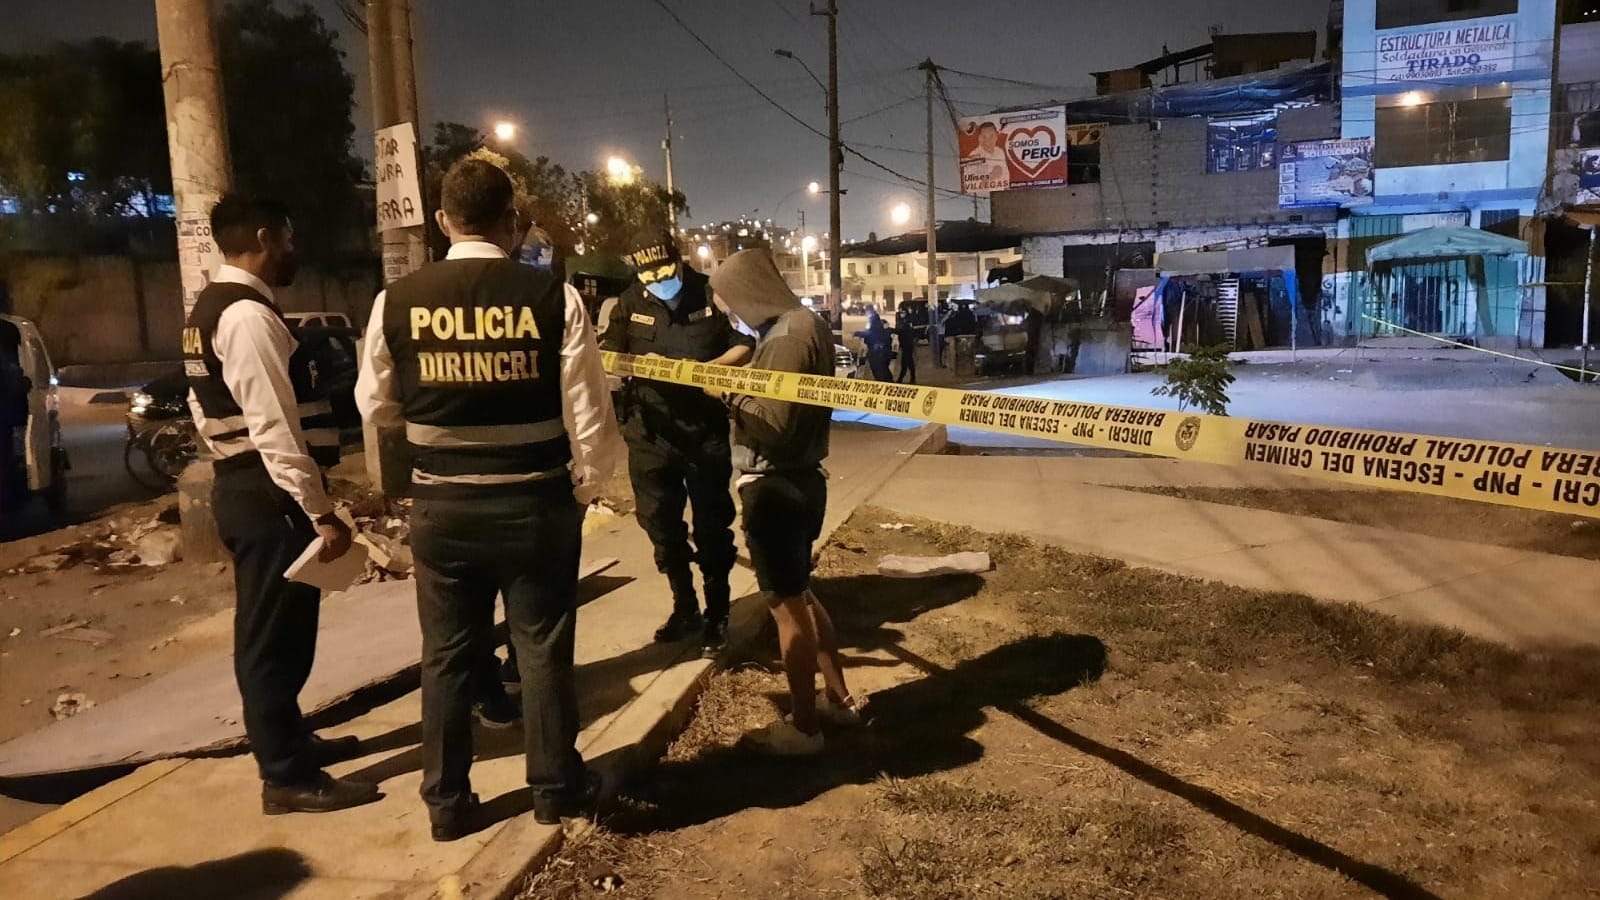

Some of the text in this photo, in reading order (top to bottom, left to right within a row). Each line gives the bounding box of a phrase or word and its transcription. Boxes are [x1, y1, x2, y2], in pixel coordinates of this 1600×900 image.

[1380, 24, 1511, 52] ESTRUCTURA METALICA
[1381, 49, 1447, 63] Soldadura
[1449, 48, 1461, 56] en
[1406, 53, 1481, 72] TIRADO
[376, 137, 399, 157] TAR
[1008, 138, 1040, 149] SOMOS
[1021, 145, 1061, 161] PERU
[964, 173, 989, 182] Ulises
[964, 179, 1009, 191] VILLEGAS
[418, 350, 540, 382] DIRINCRI
[796, 388, 818, 401] CRIMEN
[798, 376, 919, 399] BARRERA POLICIAL PROHIBIDO PASAR
[821, 391, 832, 402] DEL
[833, 393, 857, 406] ESCENA
[864, 396, 877, 409] PNP
[884, 398, 911, 414] DIRCRI
[960, 392, 1166, 427] BARRERA POLICIAL PROHIBIDO PASAR
[960, 408, 995, 425] CRIMEN
[999, 412, 1017, 428] DEL
[1019, 415, 1059, 434] ESCENA
[1072, 421, 1095, 438] PNP
[1108, 425, 1153, 446] DIRCRI
[1244, 422, 1302, 443] PASAR
[1304, 428, 1418, 456] PROHIBIDO
[1244, 442, 1313, 469] CRIMEN
[1320, 451, 1355, 474] DEL
[1425, 440, 1532, 469] POLICIAL
[1363, 455, 1445, 486] ESCENA
[1473, 470, 1522, 496] PNP
